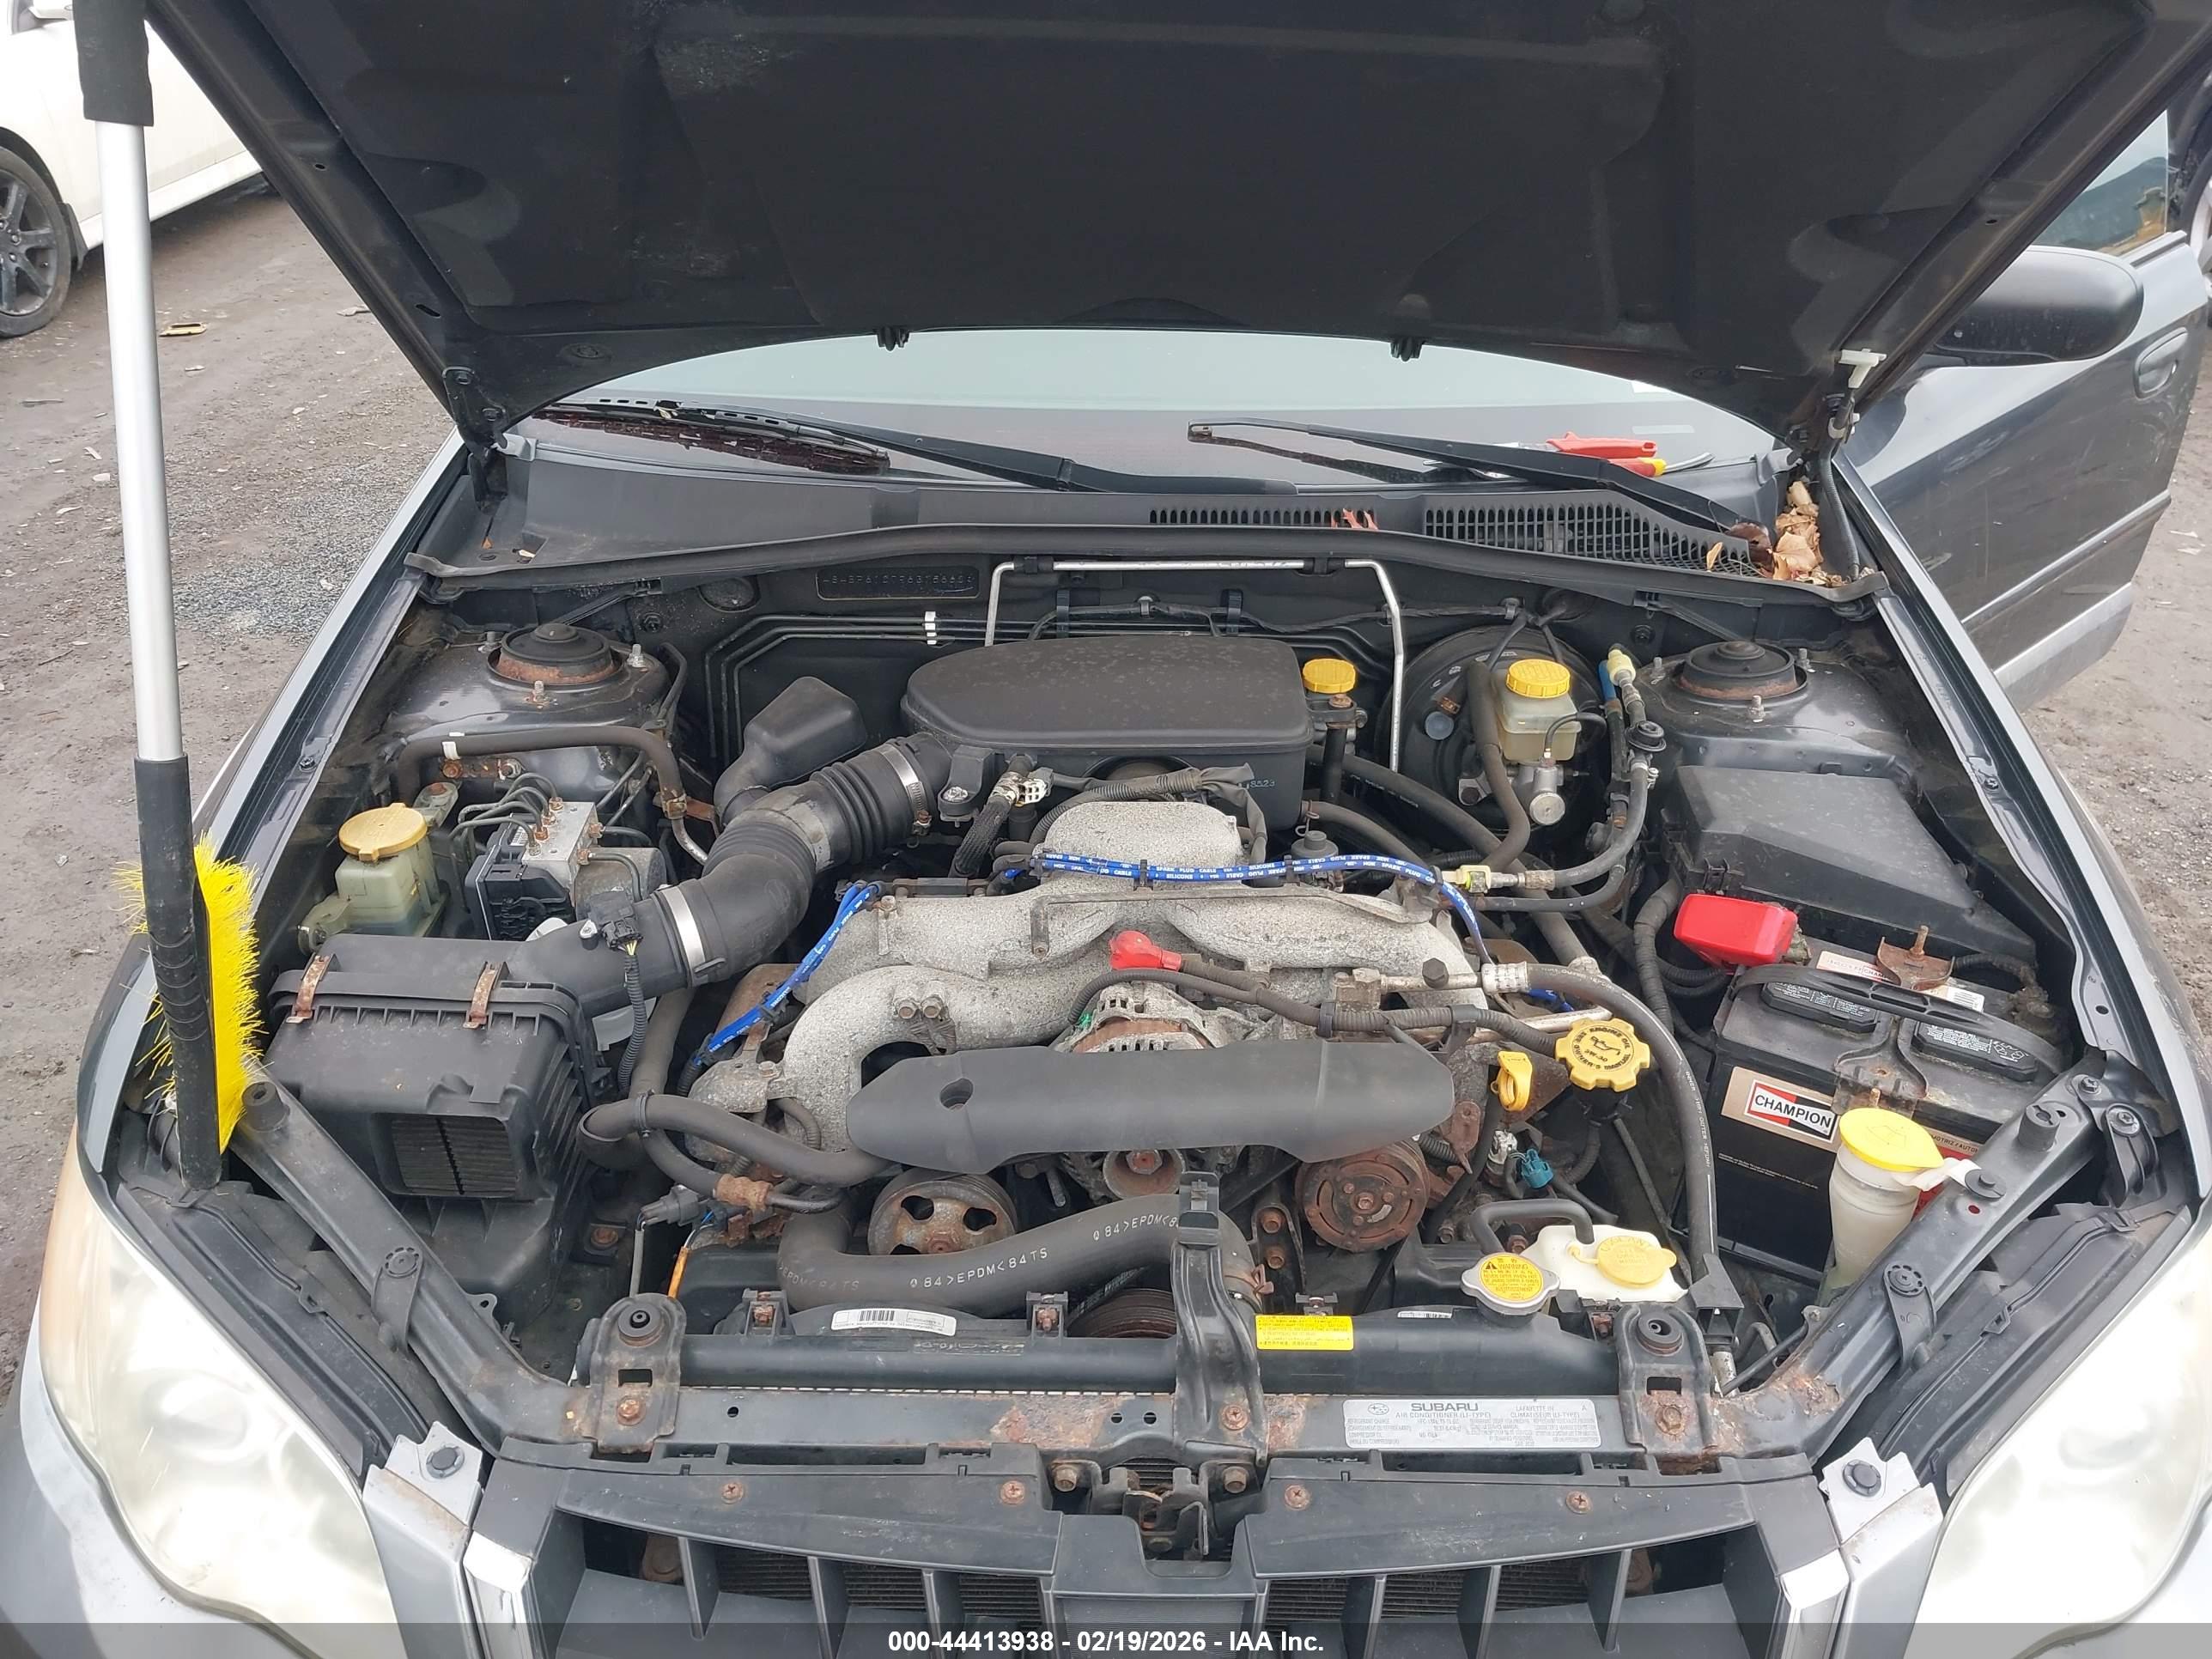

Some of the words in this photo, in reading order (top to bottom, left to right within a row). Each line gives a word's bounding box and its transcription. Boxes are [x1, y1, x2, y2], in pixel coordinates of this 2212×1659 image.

[1381, 862, 1401, 872] SPARK
[1405, 867, 1421, 878] PLUG
[1589, 1026, 1622, 1037] ENGINE
[1620, 1037, 1631, 1049] OIL
[1584, 1048, 1608, 1062] 5W-30
[1603, 1053, 1632, 1070] MANUAL
[1685, 1071, 1697, 1091] INNER
[1698, 1116, 1708, 1139] OUTER
[1753, 1095, 1832, 1129] CHAMPION
[1410, 1401, 1479, 1413] SUBARU
